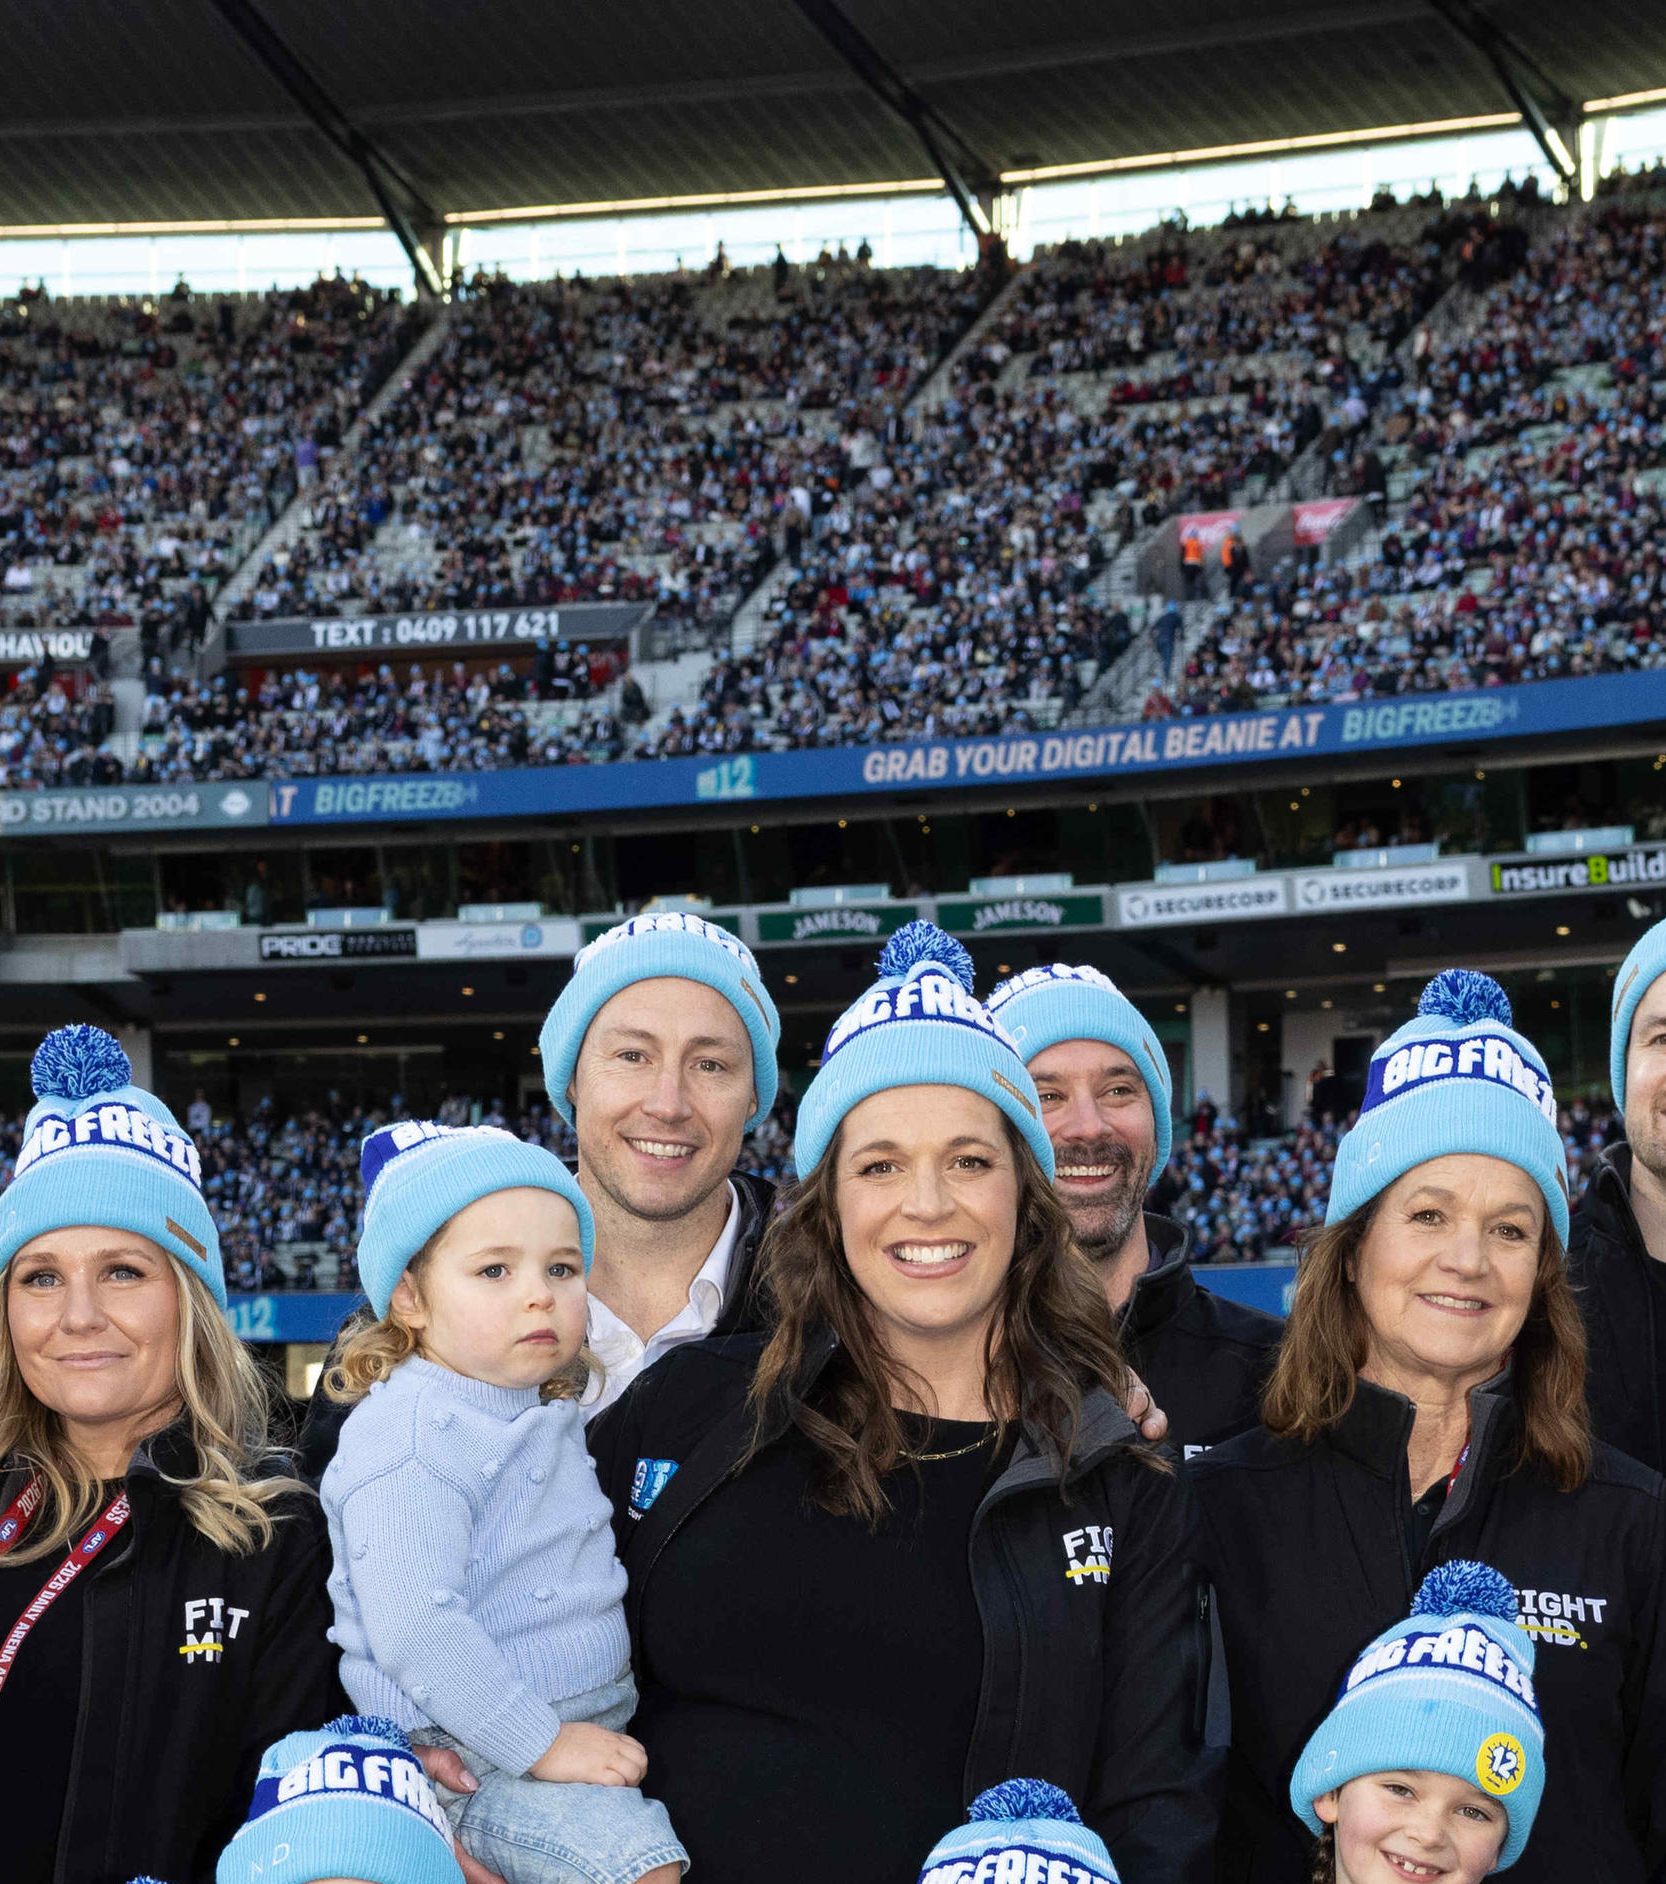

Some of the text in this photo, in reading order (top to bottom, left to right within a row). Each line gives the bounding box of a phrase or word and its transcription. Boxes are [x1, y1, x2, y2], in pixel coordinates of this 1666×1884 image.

[311, 621, 377, 648] TEXT
[395, 616, 457, 643] 0409
[466, 613, 510, 639] 117
[514, 611, 559, 637] 621
[863, 749, 948, 784] GRAB
[955, 741, 1037, 778] YOUR
[1040, 732, 1156, 771] DIGITAL
[1164, 718, 1271, 761] BEANIE
[1278, 713, 1323, 751] AT
[32, 795, 127, 824] STAND
[134, 792, 200, 820] 2004
[1155, 889, 1277, 914] SECURECORP
[1331, 876, 1461, 899] SECURECORP
[793, 911, 881, 940] JAMESON
[973, 900, 1064, 931] JAMESON
[262, 933, 343, 958] PRIDE
[1383, 1042, 1454, 1095] BIG
[0, 1520, 17, 1540] AFL
[84, 1532, 105, 1553] AFL
[54, 1560, 81, 1591] 2026
[24, 1586, 56, 1622] DAILY
[0, 1620, 31, 1663] ARENA
[1406, 1627, 1537, 1709] FREEZE
[277, 1751, 359, 1803] BIG
[1492, 1746, 1518, 1780] 12
